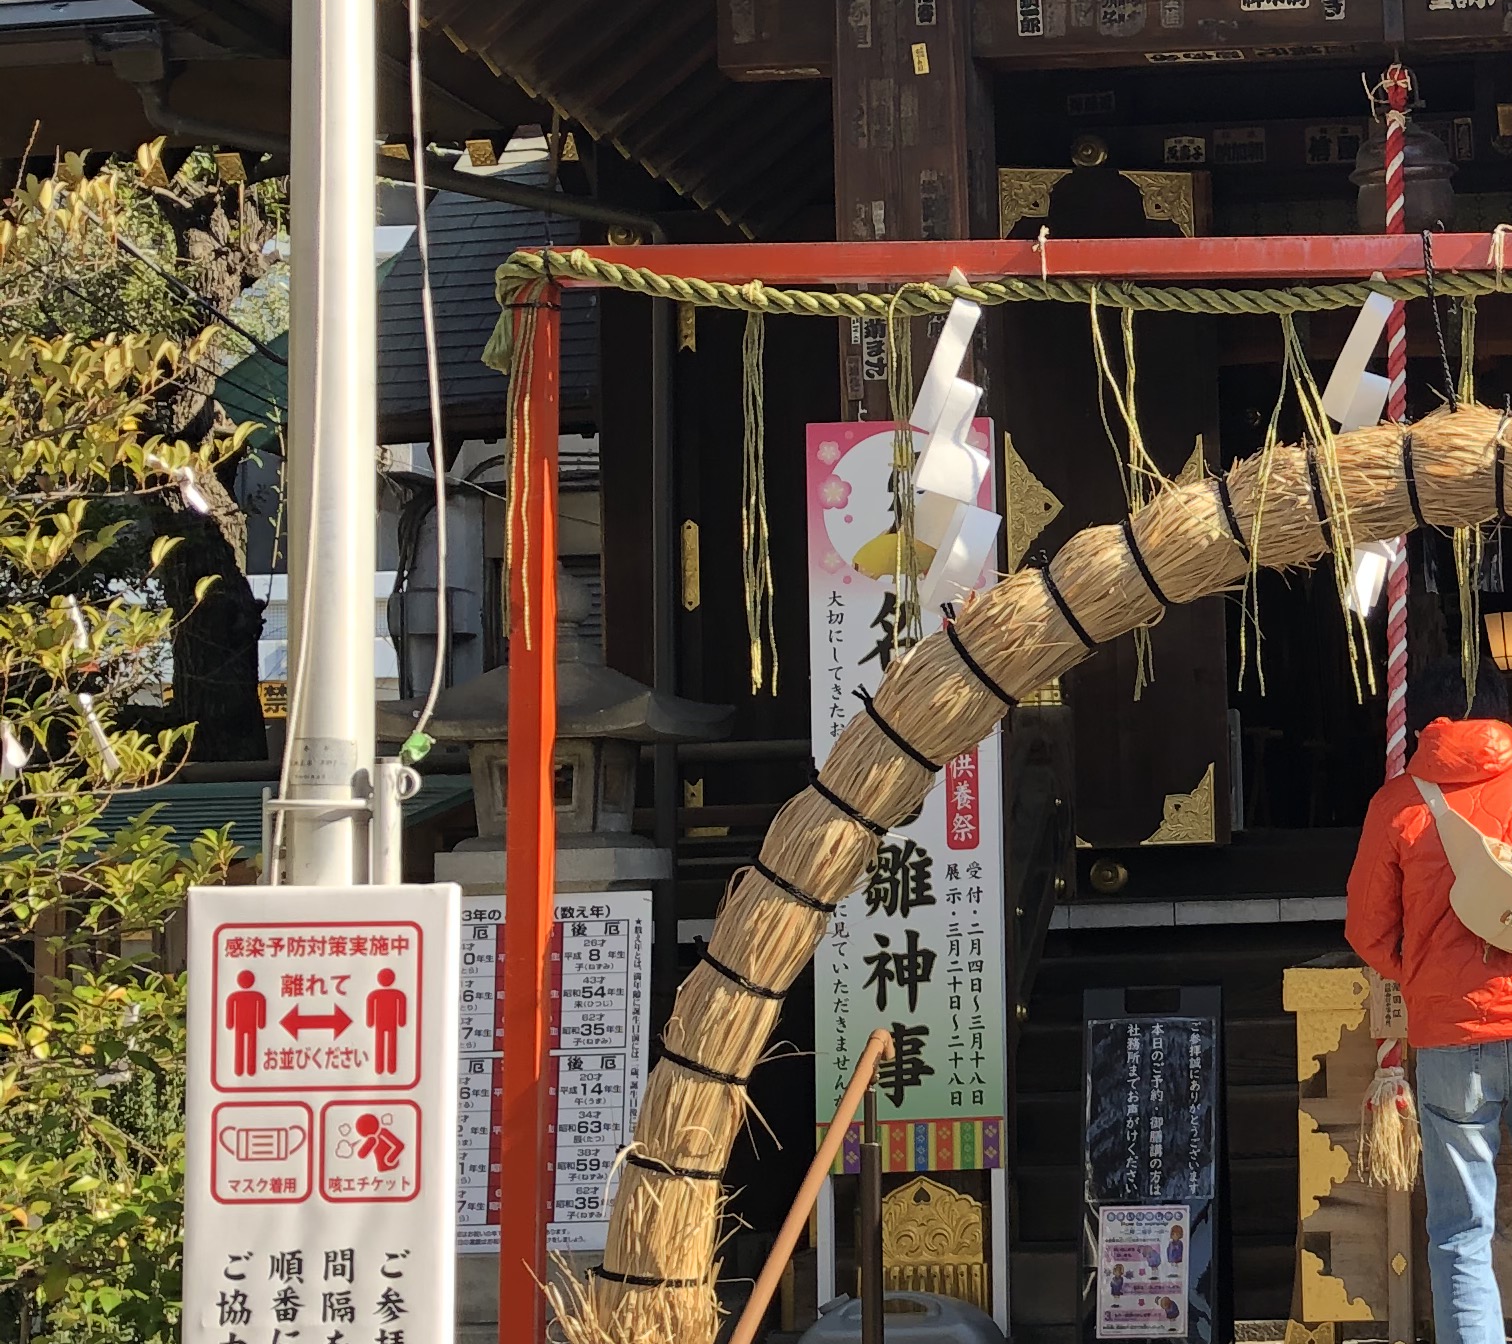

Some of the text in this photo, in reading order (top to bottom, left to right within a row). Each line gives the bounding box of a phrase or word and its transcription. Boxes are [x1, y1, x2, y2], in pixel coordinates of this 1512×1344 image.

[554, 905, 611, 920] (数え年)
[224, 935, 410, 958] 感染予防対策実施中
[280, 974, 351, 998] 離れて
[563, 986, 624, 998] 昭和54年生
[562, 1023, 623, 1036] 昭和35年生
[263, 1047, 370, 1071] お並びください
[560, 1083, 622, 1096] 平成14年生
[1126, 1024, 1141, 1194] 社務所までお声がけください
[559, 1121, 620, 1133] 昭和63年生
[228, 1177, 297, 1194] マスク着用
[328, 1176, 411, 1194] 咳エチケット
